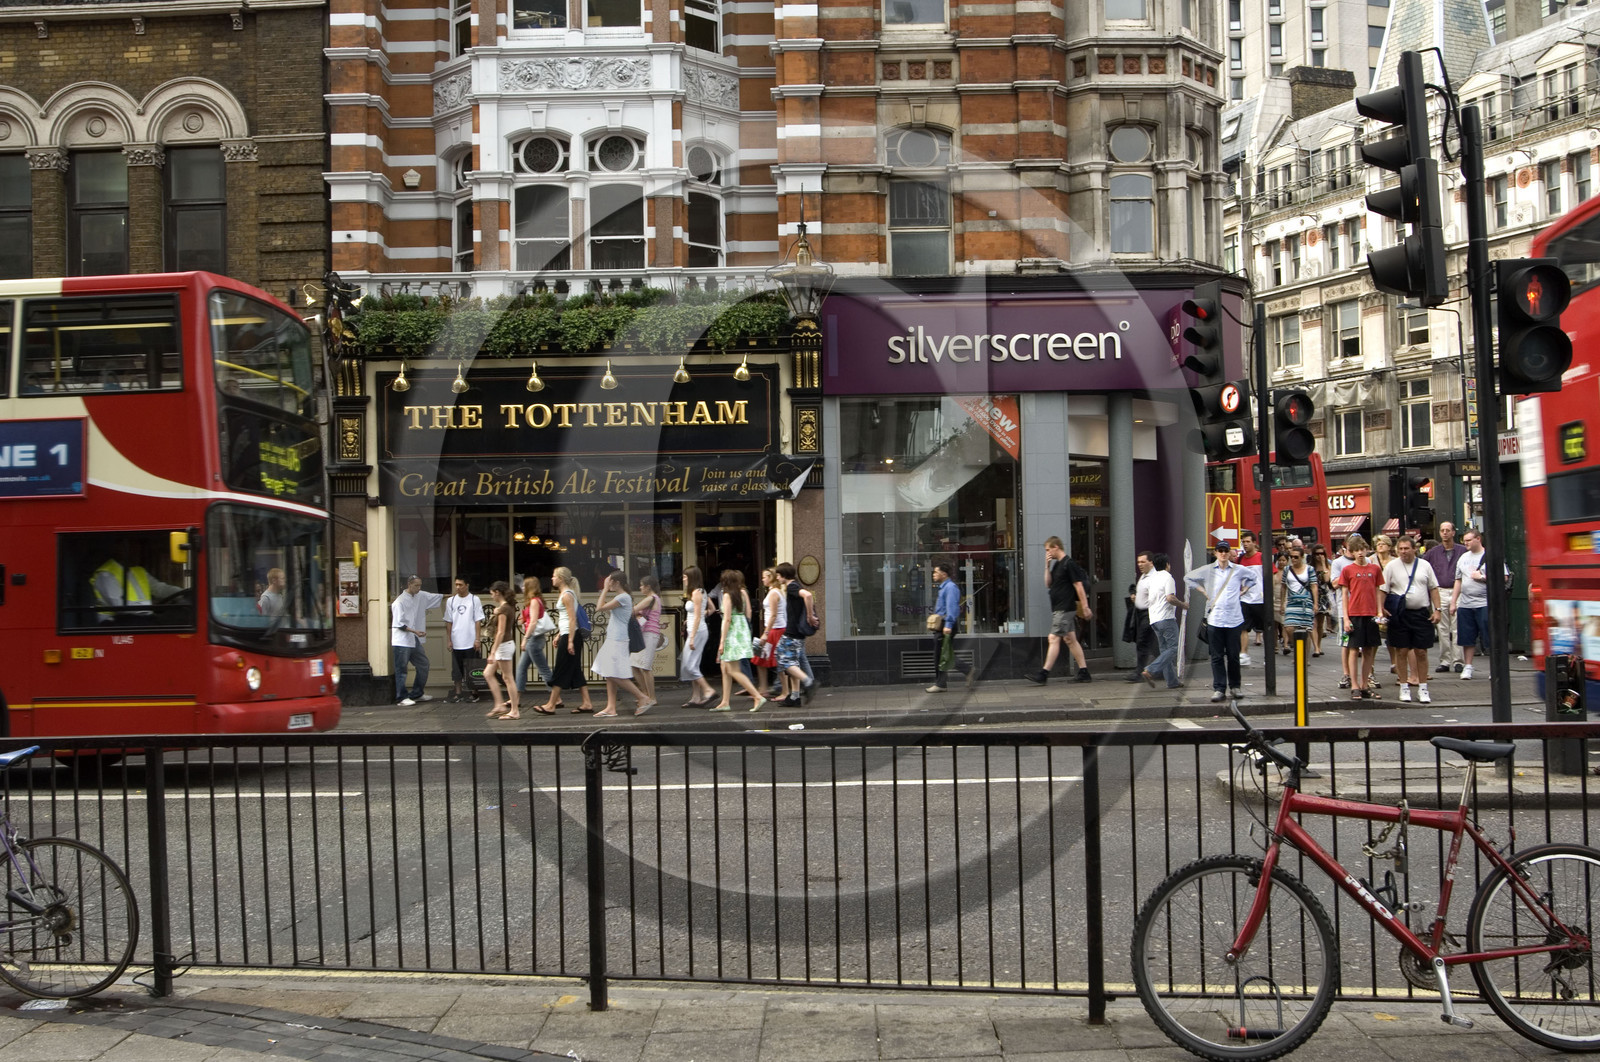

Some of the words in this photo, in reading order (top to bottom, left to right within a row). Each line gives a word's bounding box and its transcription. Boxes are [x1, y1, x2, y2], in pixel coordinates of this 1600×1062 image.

[403, 404, 483, 430] THE
[500, 400, 749, 429] TOTTENHAM
[979, 398, 1018, 432] new
[49, 443, 69, 466] 1
[399, 472, 468, 497] Great
[474, 470, 554, 496] British
[558, 468, 597, 495] Ale
[601, 467, 691, 494] Festival
[700, 467, 725, 483] Join
[729, 470, 742, 479] us
[745, 464, 768, 478] and
[702, 482, 728, 492] raise
[731, 483, 738, 491] a
[740, 478, 768, 495] glass
[1345, 873, 1395, 920] PRO
